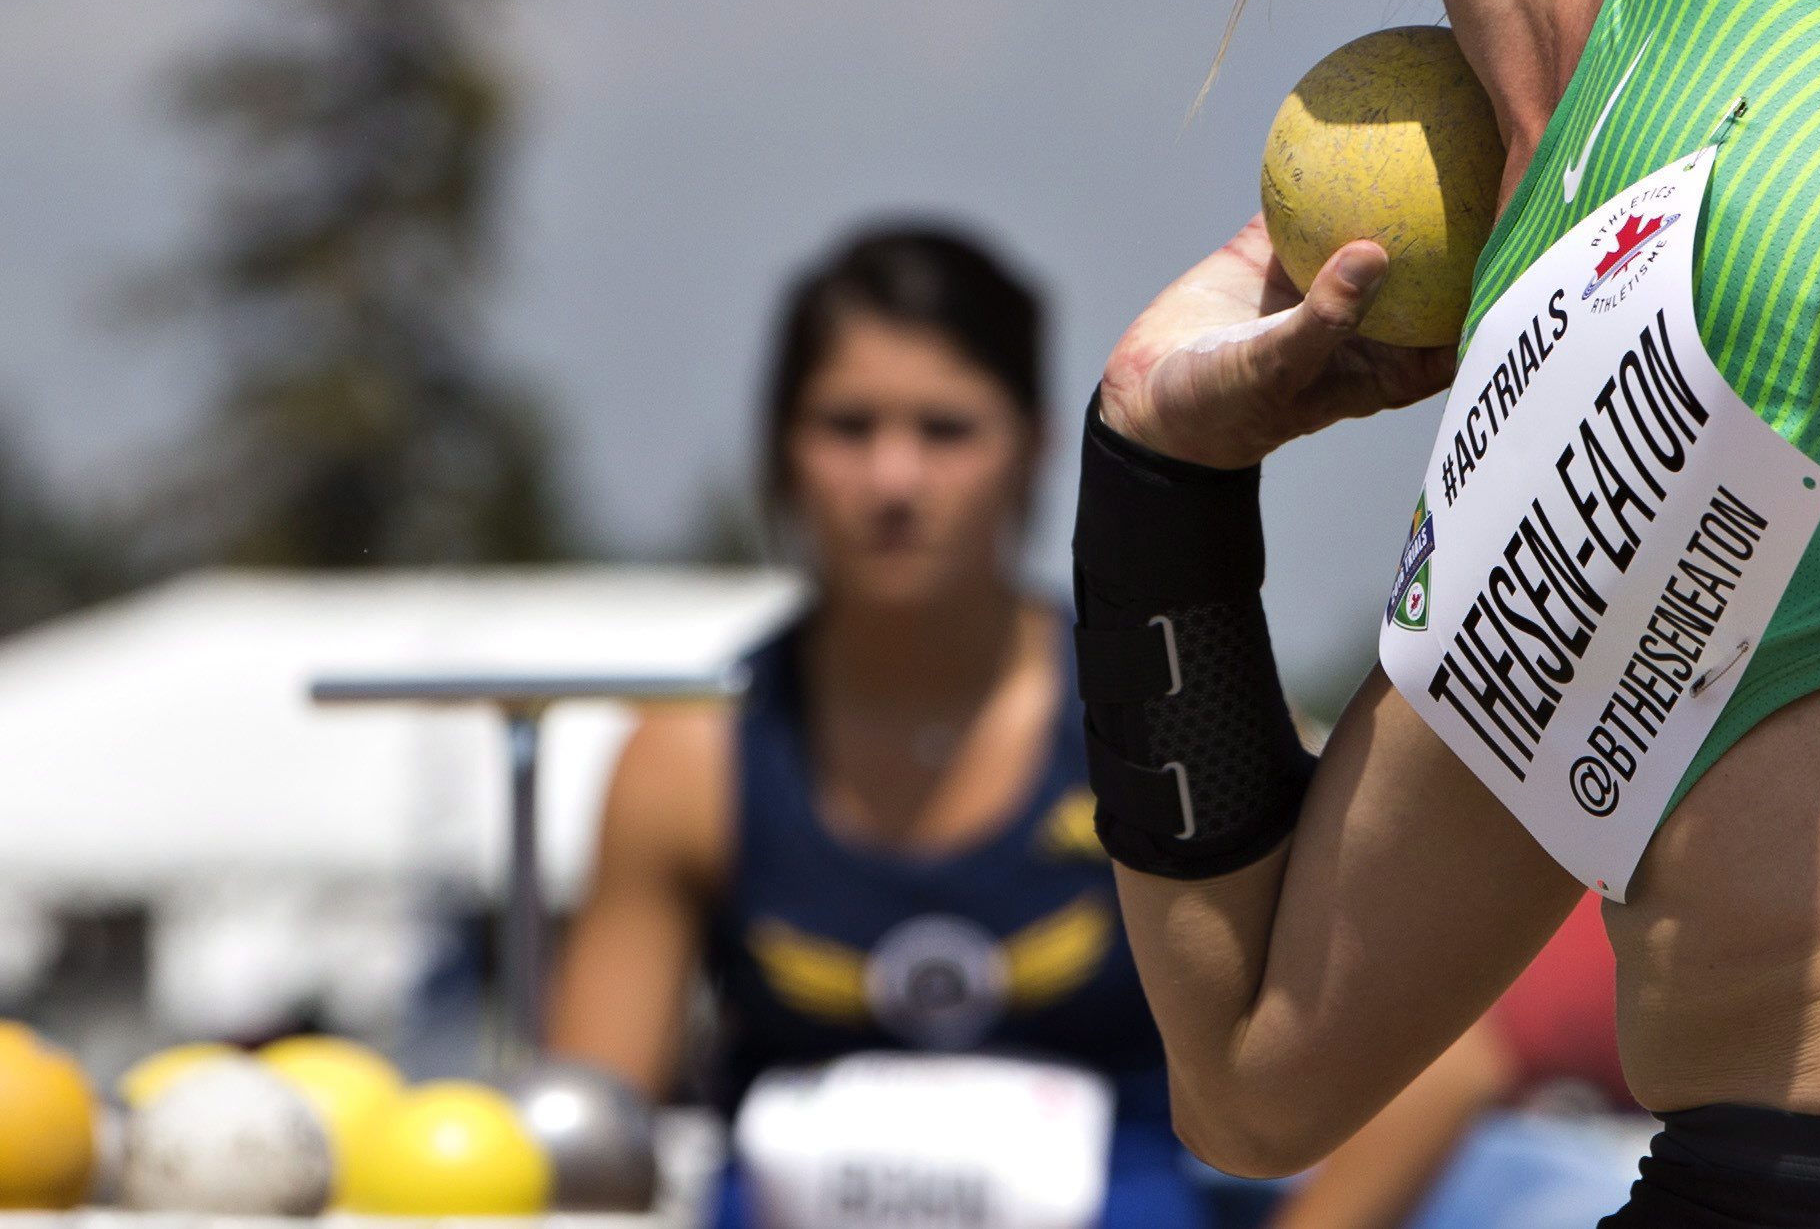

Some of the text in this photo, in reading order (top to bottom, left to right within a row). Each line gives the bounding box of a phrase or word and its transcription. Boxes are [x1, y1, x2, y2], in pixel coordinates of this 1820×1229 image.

[1590, 185, 1676, 248] ATHLETICS
[1441, 288, 1569, 507] #ACTRIALS
[1427, 308, 1711, 783] THEISEN-EATON
[1568, 484, 1769, 819] @BTHEISENEATON
